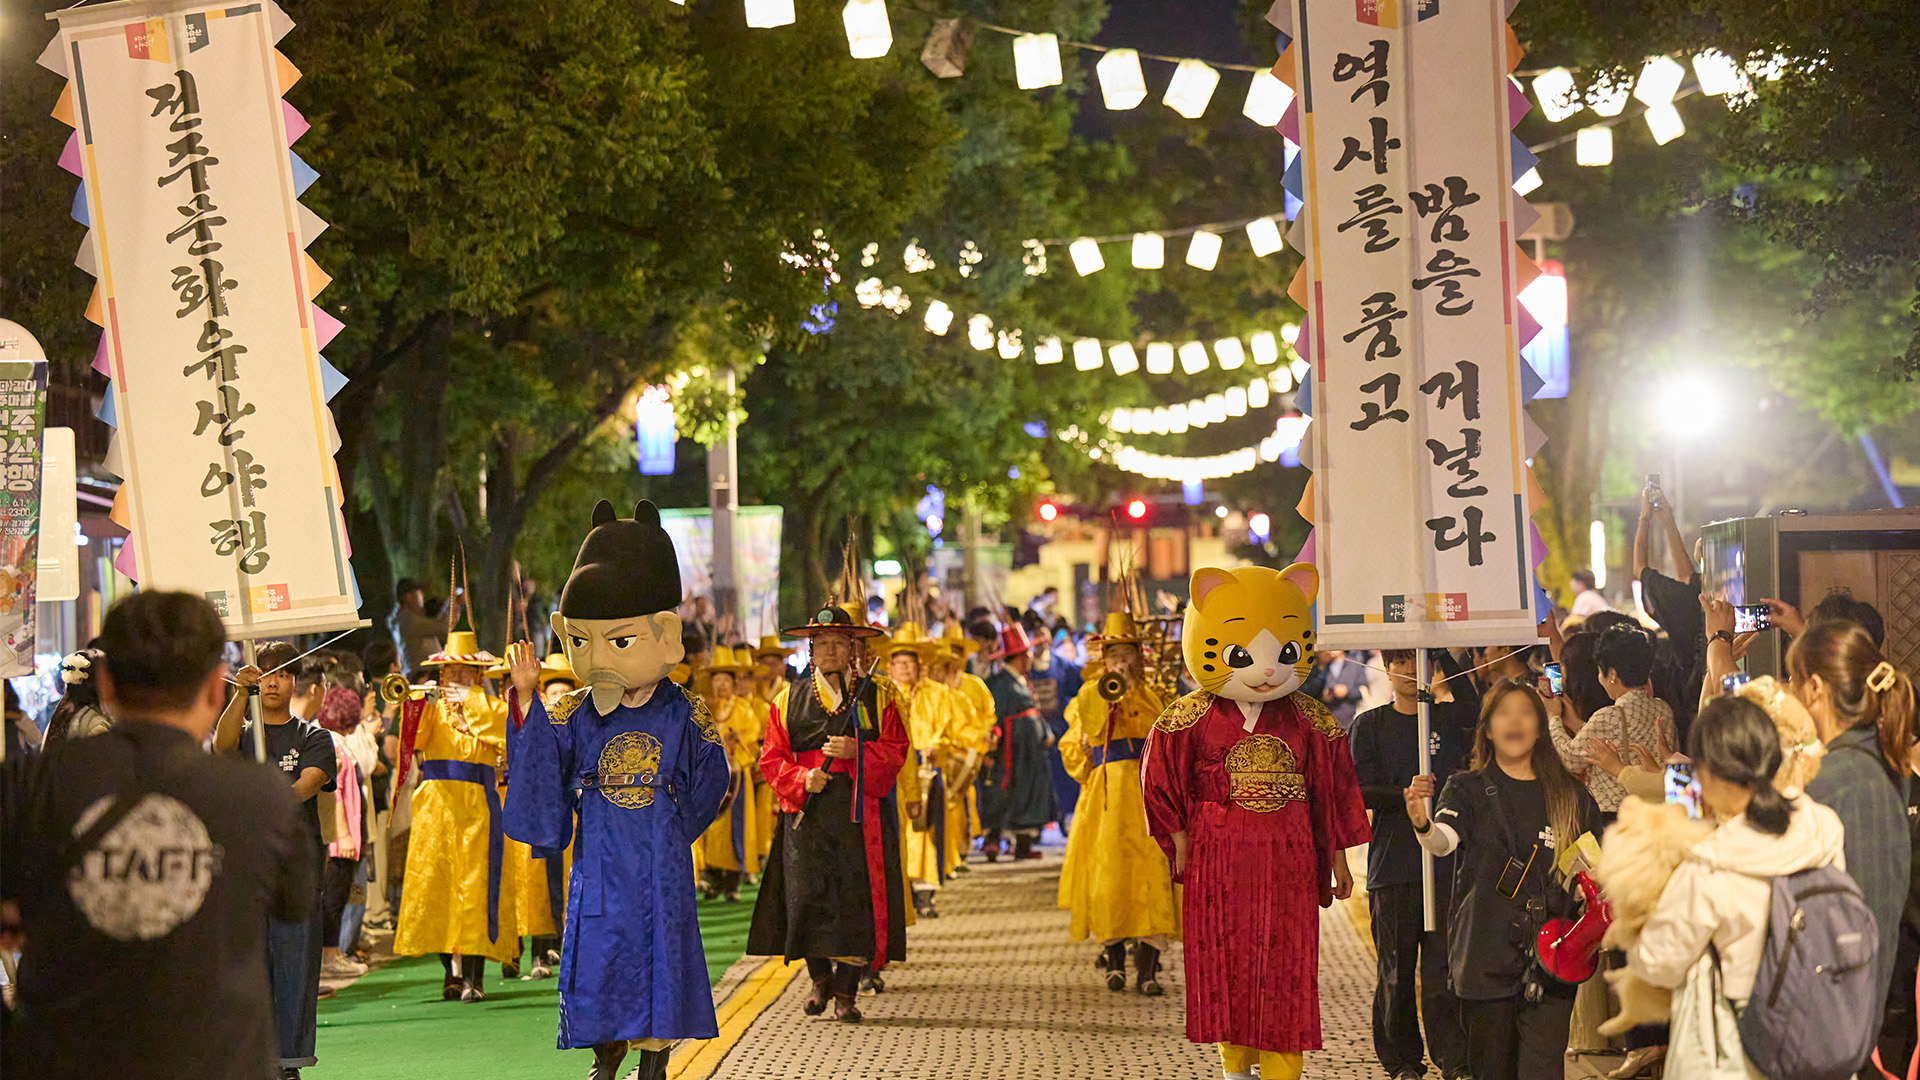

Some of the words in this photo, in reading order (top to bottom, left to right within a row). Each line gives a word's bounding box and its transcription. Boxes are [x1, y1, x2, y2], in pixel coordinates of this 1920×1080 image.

[1332, 39, 1404, 254] 역사를
[1408, 175, 1482, 317] 밤을
[145, 69, 272, 575] 전주문화유산야행
[1342, 291, 1410, 431] 품고
[1418, 359, 1497, 567] 거닐다
